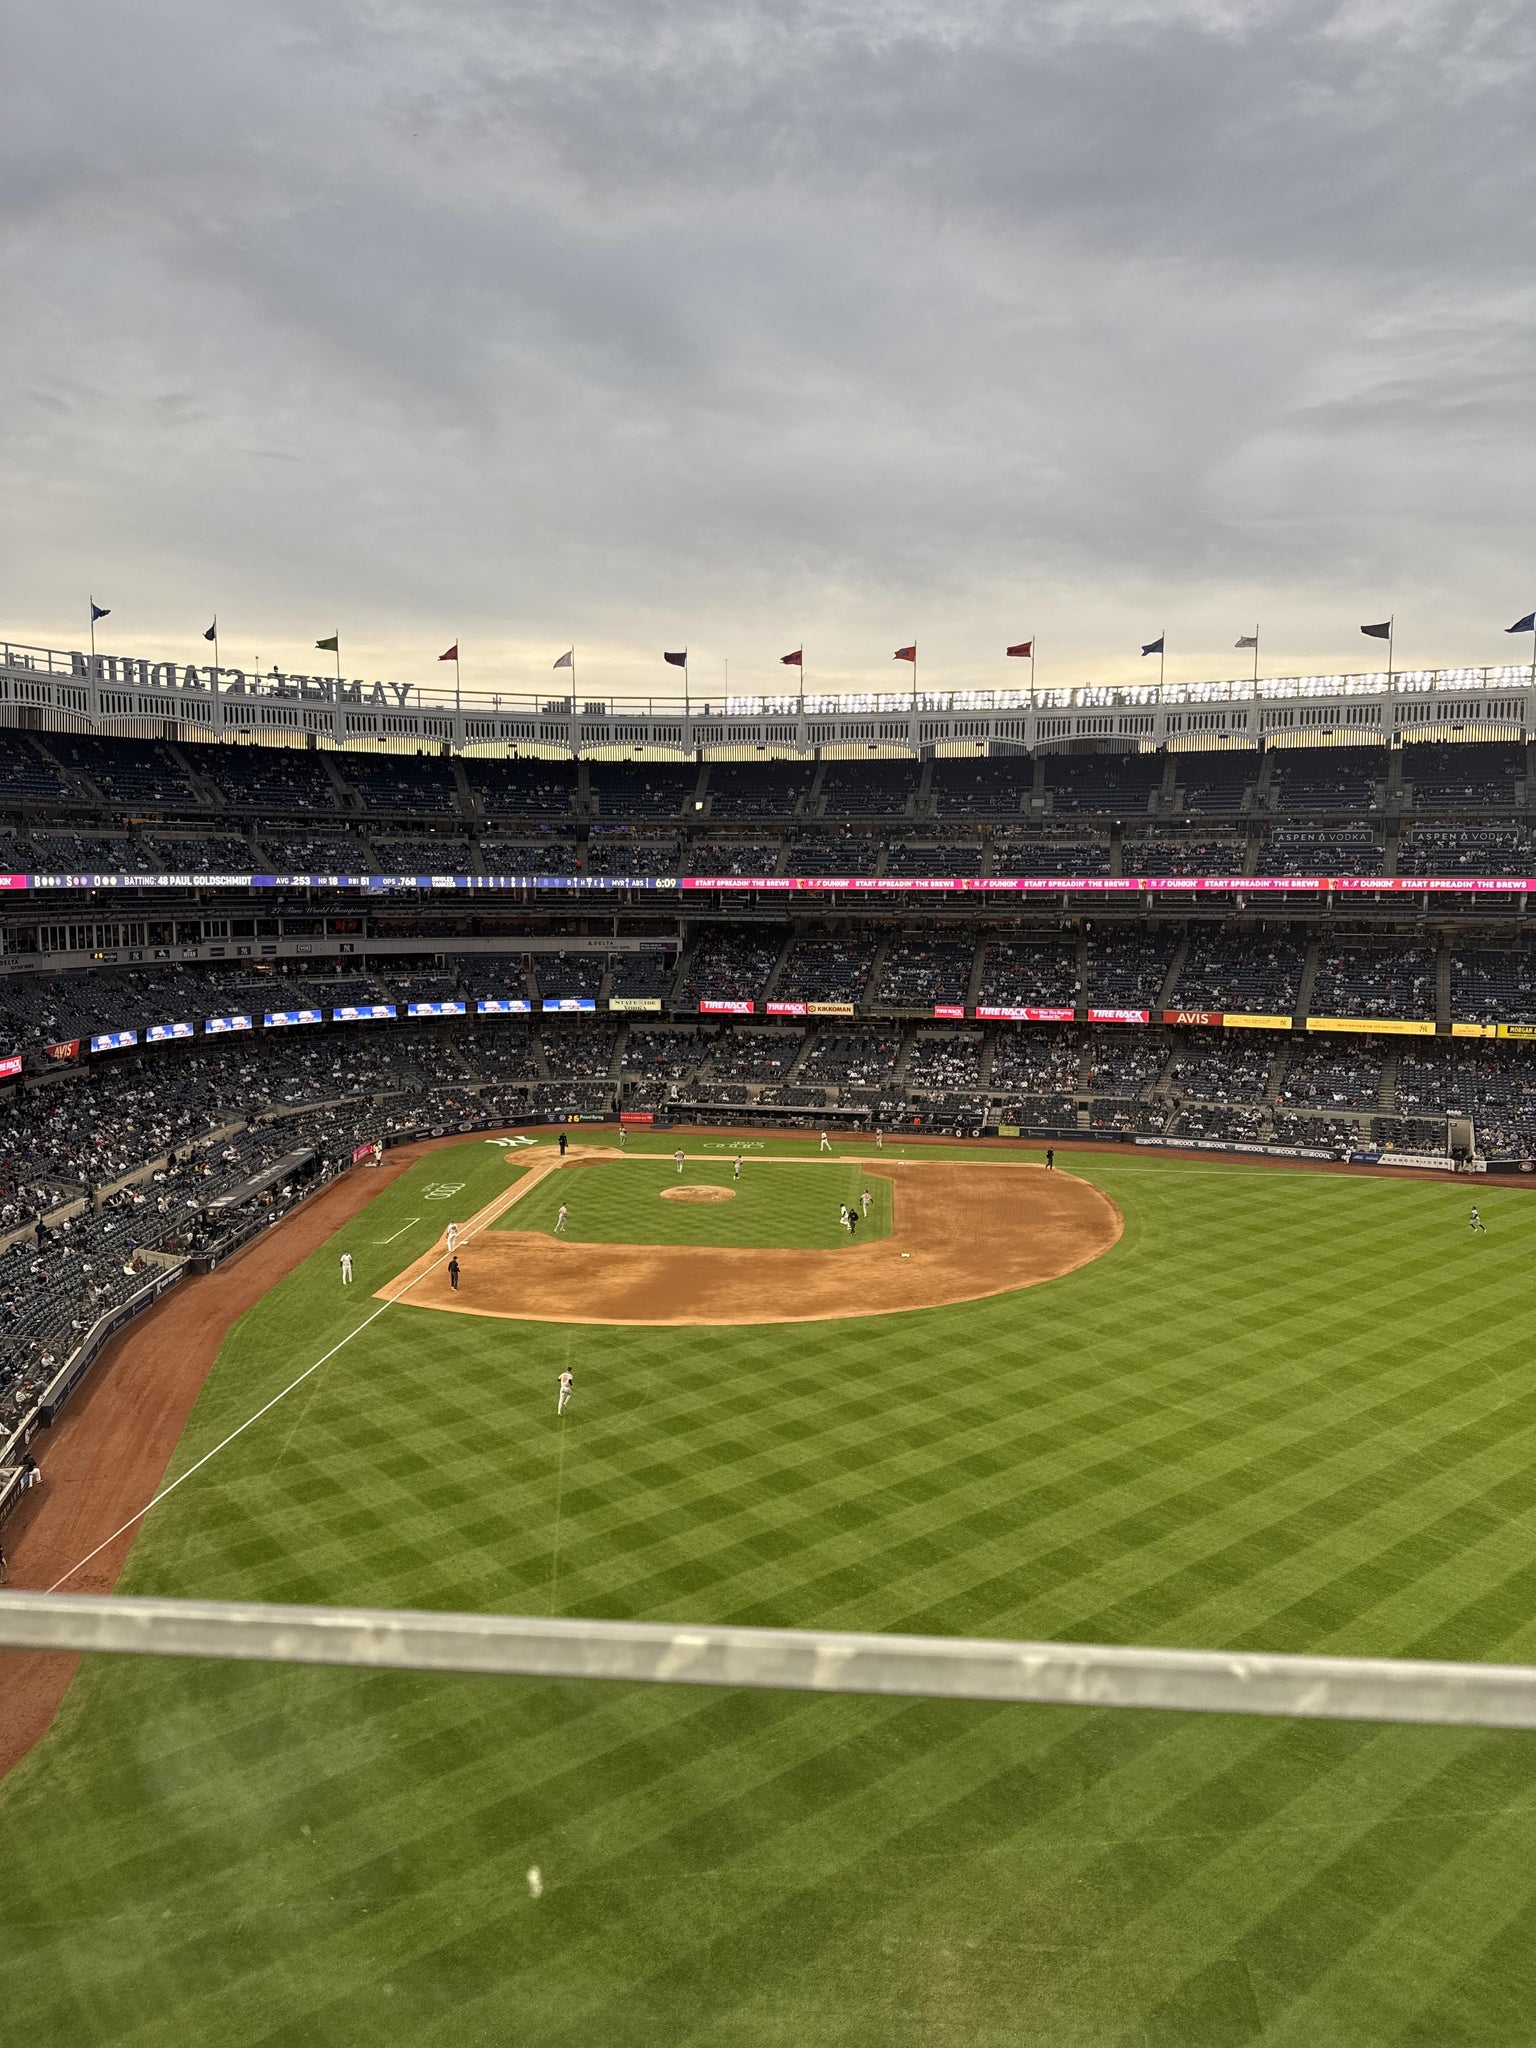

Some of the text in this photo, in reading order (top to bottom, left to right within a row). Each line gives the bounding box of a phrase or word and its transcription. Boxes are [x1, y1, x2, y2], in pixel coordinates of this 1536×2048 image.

[34, 876, 40, 887] B
[66, 876, 72, 887] S
[124, 876, 252, 885] BATTING: 48 PAUL GOLDSCHMIDT
[291, 876, 310, 885] .253
[328, 877, 338, 885] 18
[361, 877, 369, 885] 51
[398, 877, 416, 886] .768
[656, 878, 676, 888] 6:09
[724, 1002, 748, 1010] RACK
[1001, 1008, 1028, 1016] RACK
[1115, 1011, 1143, 1019] RACK
[1177, 1013, 1209, 1024] AVIS
[55, 1044, 72, 1059] AVIS
